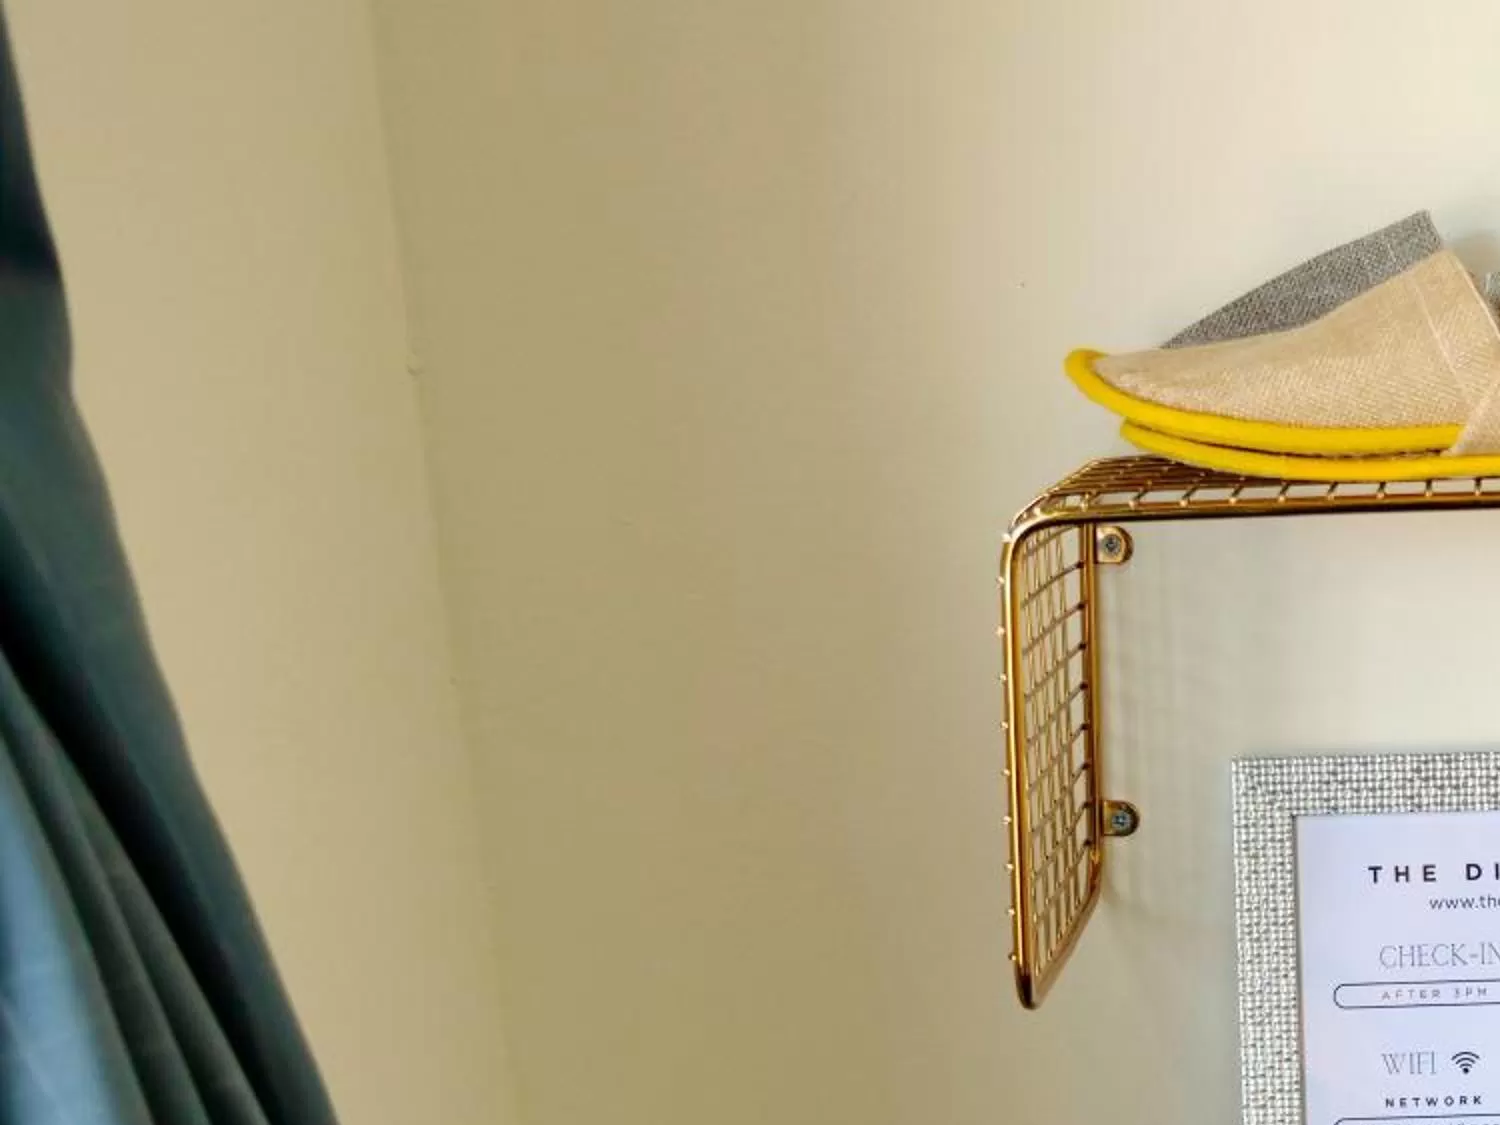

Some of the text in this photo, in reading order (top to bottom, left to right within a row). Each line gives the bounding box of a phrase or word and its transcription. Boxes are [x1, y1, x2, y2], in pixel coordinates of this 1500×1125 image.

[1368, 864, 1438, 884] THE
[1381, 986, 1489, 1001] AFTER 3PM
[1381, 1050, 1437, 1076] WIFI
[1384, 1095, 1483, 1109] NETWORK
